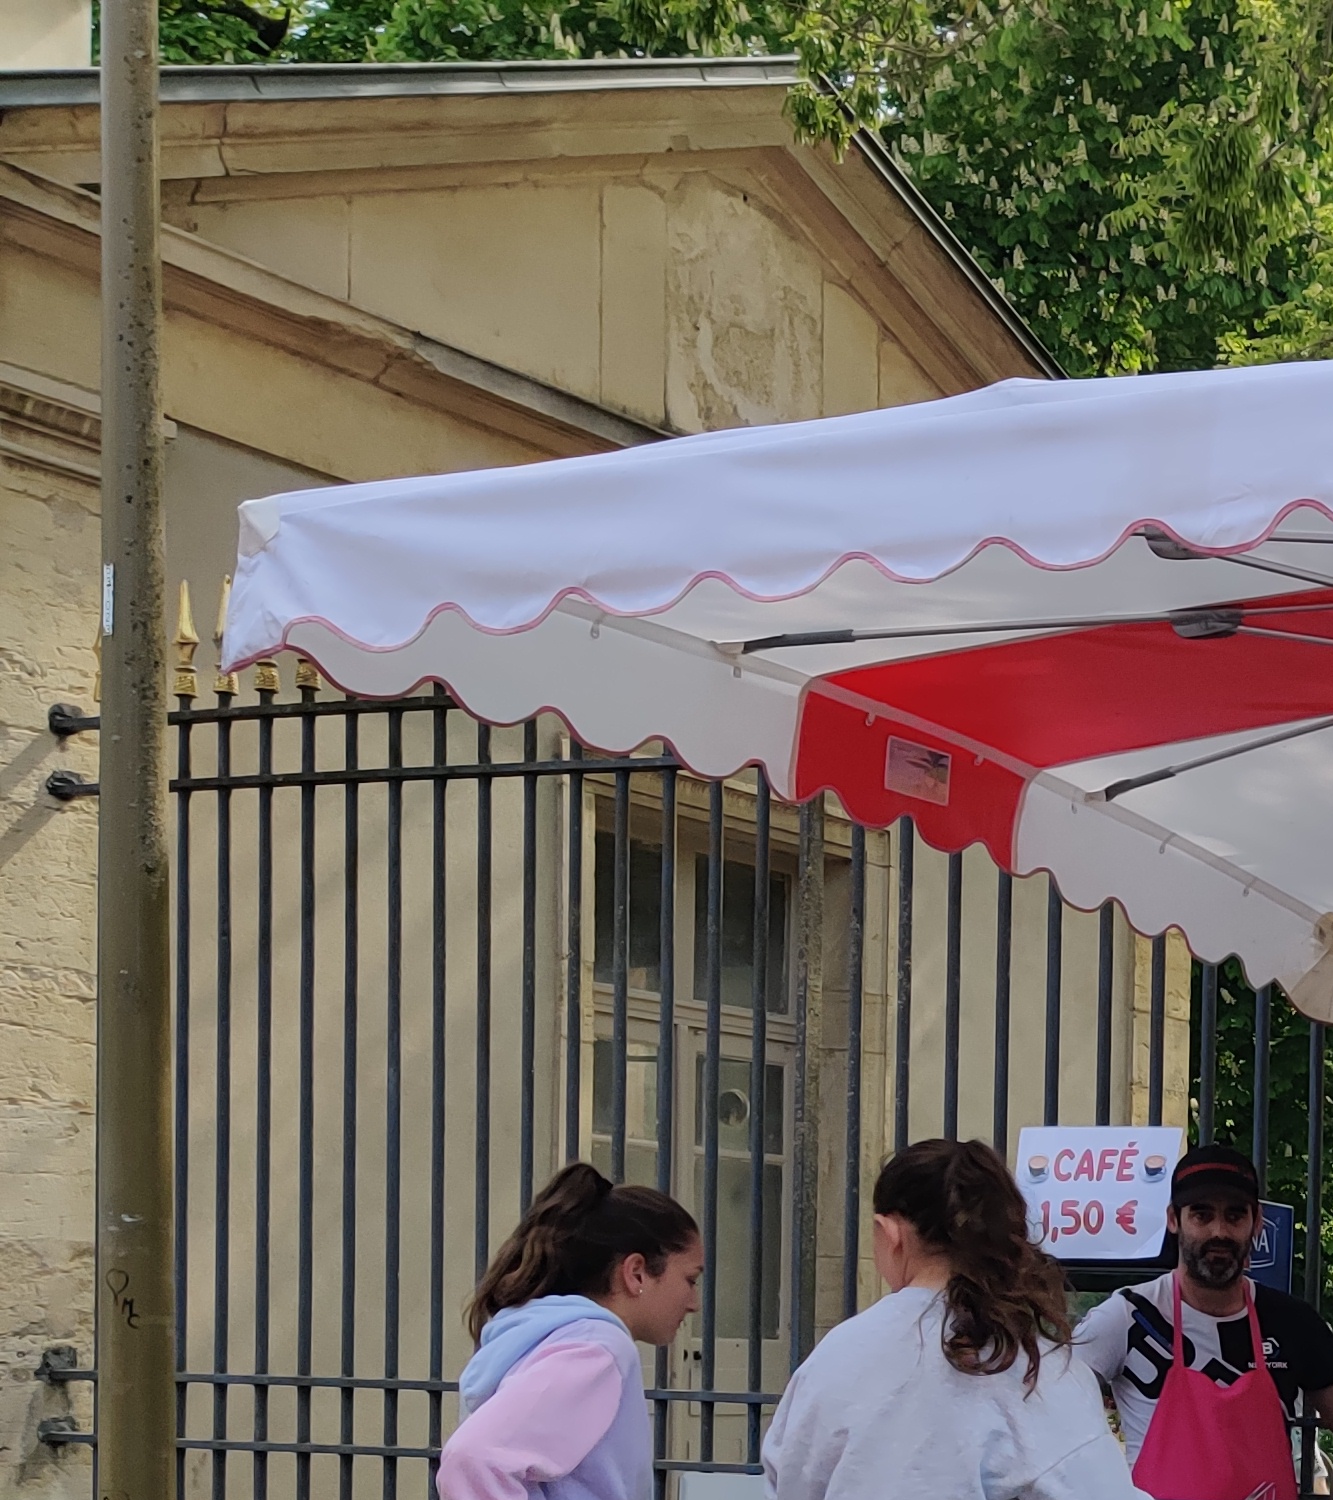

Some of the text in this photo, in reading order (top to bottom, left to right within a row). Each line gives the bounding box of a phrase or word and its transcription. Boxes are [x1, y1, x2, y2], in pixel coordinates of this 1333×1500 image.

[1054, 1141, 1139, 1182] CAFÉ
[1041, 1199, 1139, 1243] 1,50 €
